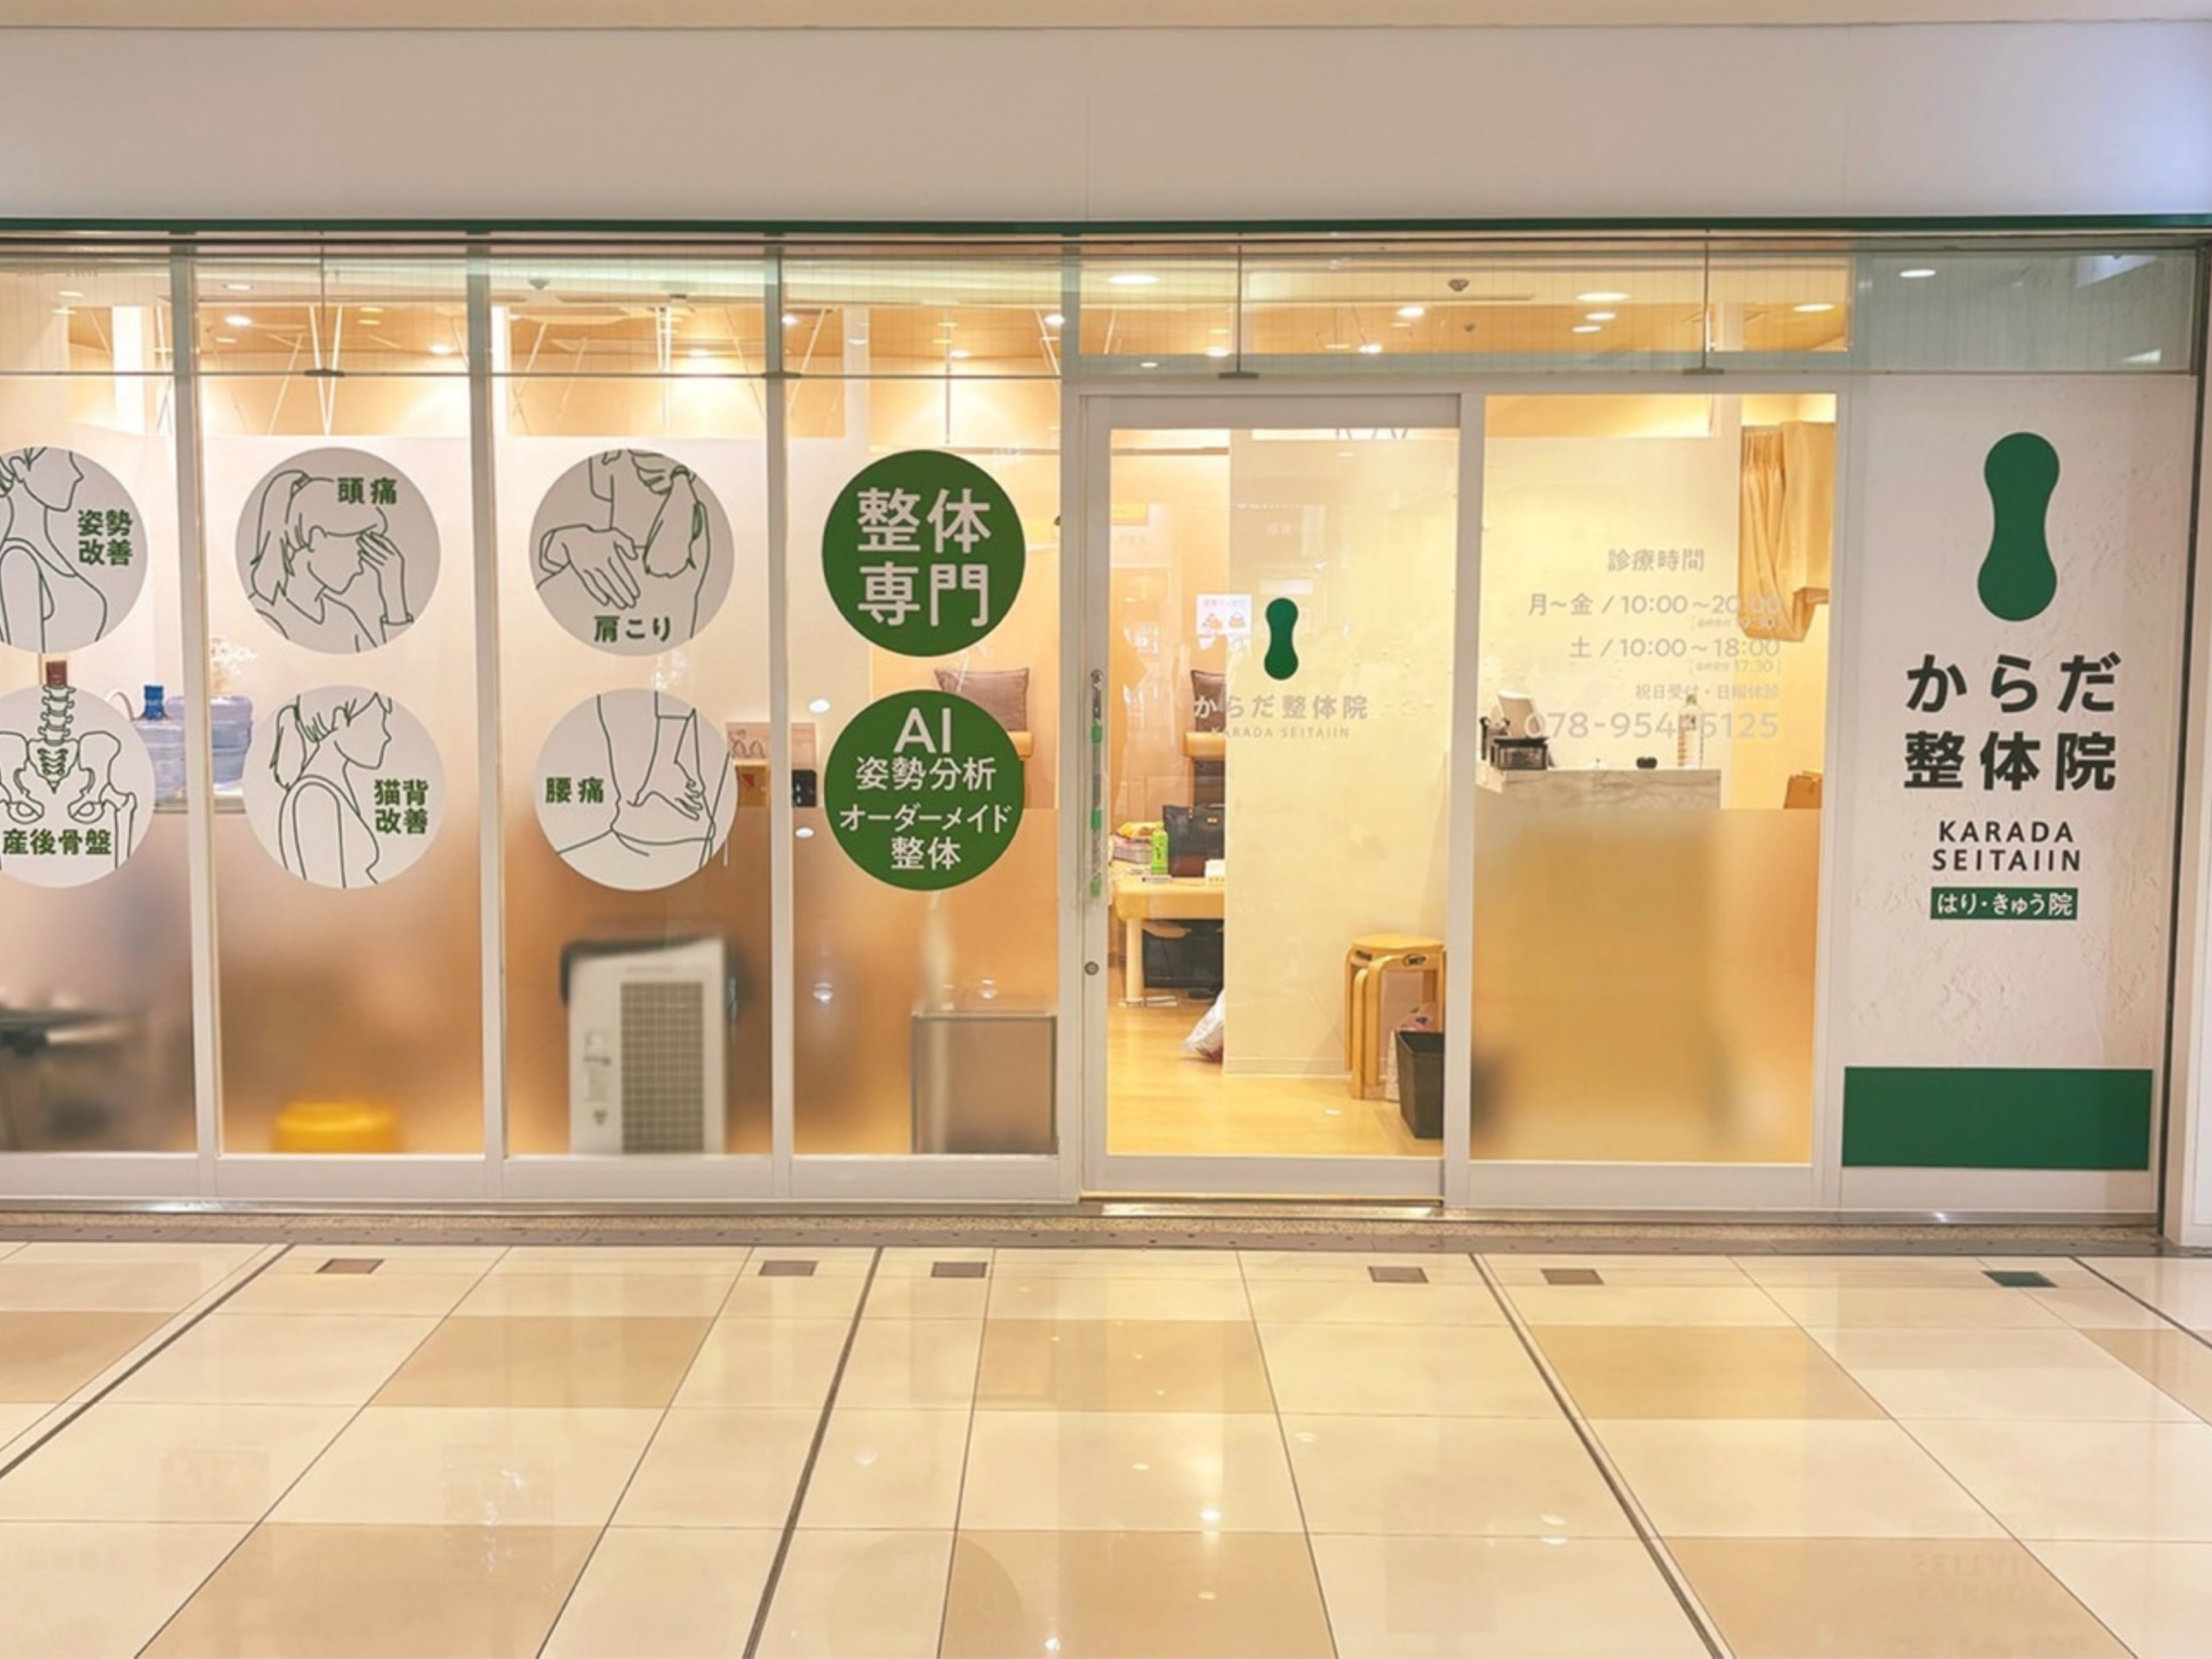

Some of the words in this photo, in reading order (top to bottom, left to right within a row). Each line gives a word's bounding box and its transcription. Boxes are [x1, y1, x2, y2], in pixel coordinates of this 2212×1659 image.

[338, 477, 397, 505] 頭痛
[78, 510, 133, 536] 姿勢
[857, 486, 991, 554] 整体
[79, 538, 133, 566] 改善
[1607, 548, 1706, 572] 診療時間
[858, 562, 988, 626] 専門
[594, 615, 671, 642] 肩こり
[1906, 652, 2121, 713] からだ
[1192, 694, 1368, 721] からだ整体院
[893, 708, 951, 753] AI
[1523, 713, 1778, 739] 078-9545125
[855, 756, 996, 791] 姿勢分析
[1904, 730, 2116, 791] 整体院
[374, 779, 429, 805] 猫背
[546, 777, 604, 804] 腰痛
[375, 808, 428, 835] 改善
[839, 802, 1012, 834] オーダーメイド
[1940, 820, 2074, 843] KARADA
[3, 829, 112, 855] 産後骨盤
[891, 836, 962, 870] 整体
[1932, 849, 2081, 872] SEITAIIN
[1937, 893, 2073, 917] はり・きゅう院
